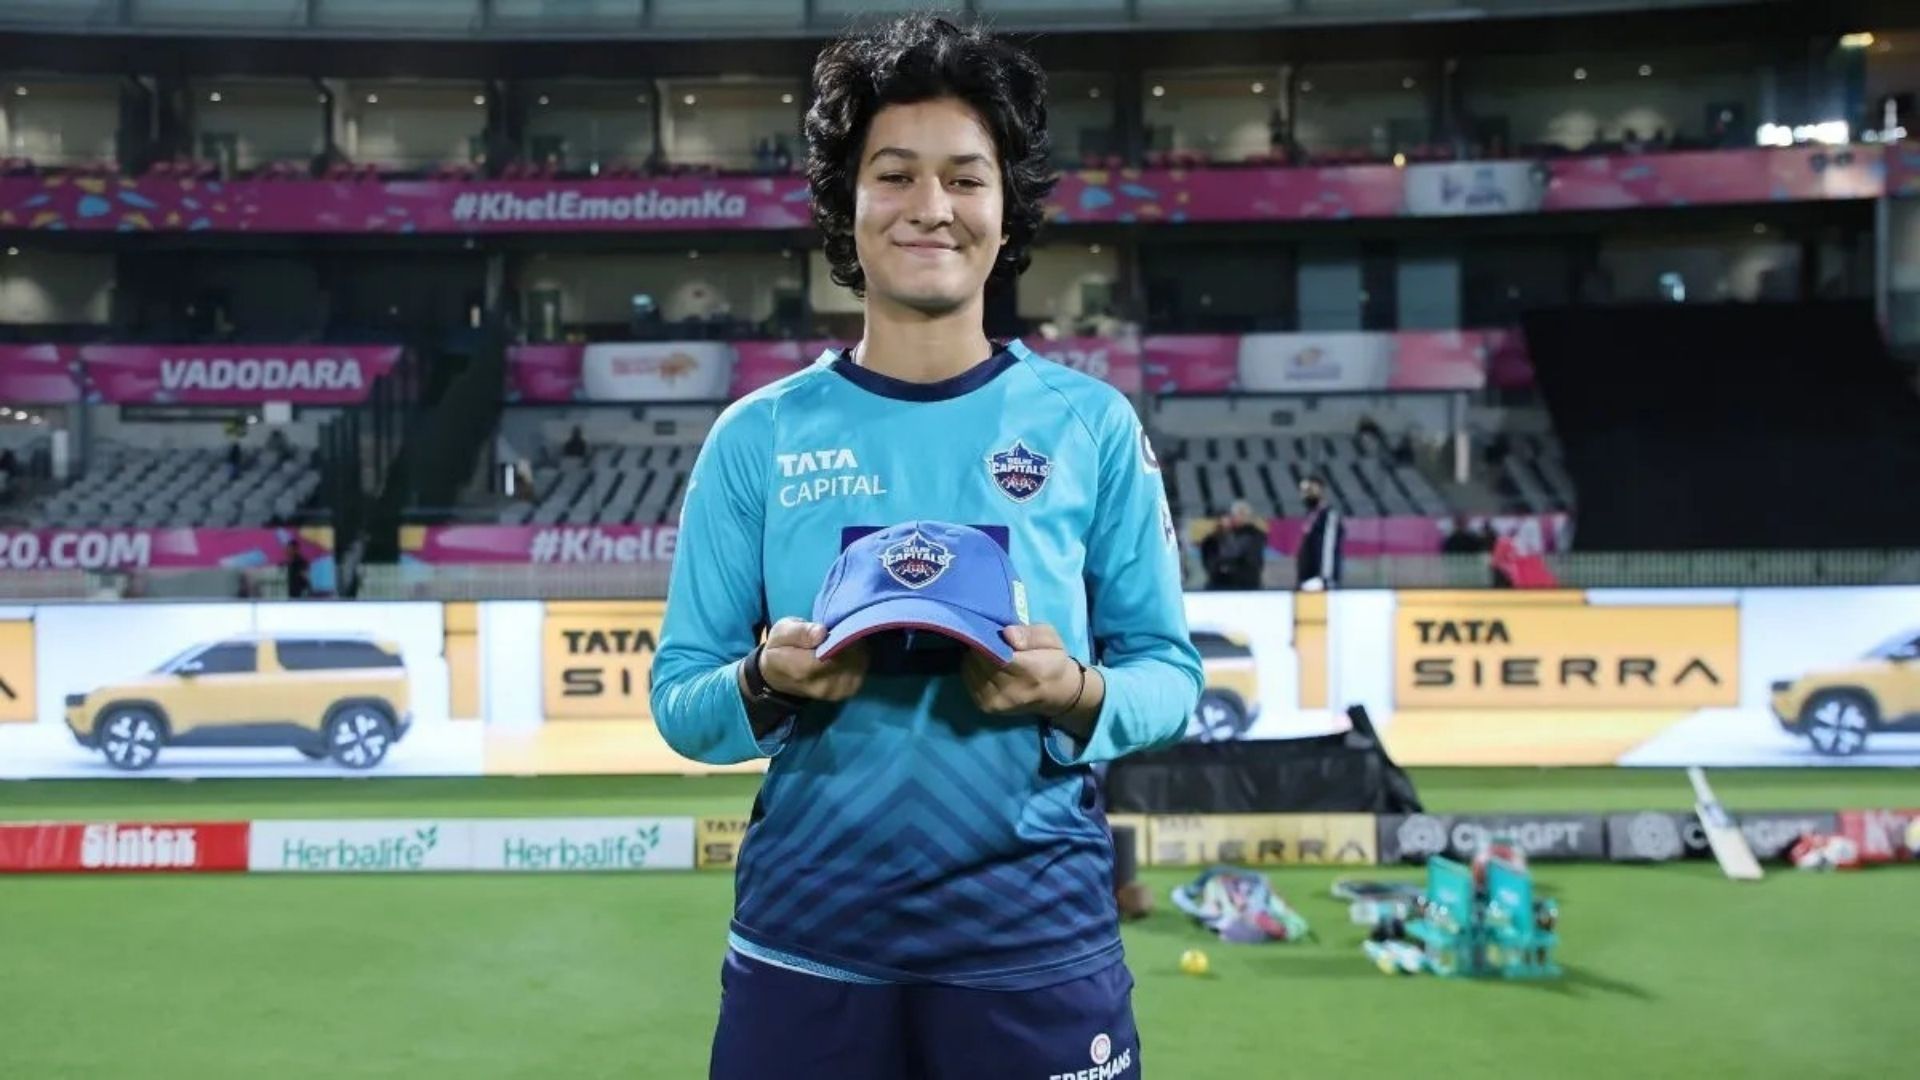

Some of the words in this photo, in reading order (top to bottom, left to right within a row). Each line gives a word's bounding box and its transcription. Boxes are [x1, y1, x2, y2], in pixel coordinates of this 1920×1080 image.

[453, 189, 746, 221] #KhelEmotionKa
[160, 358, 363, 390] VADODARA
[777, 448, 858, 477] TATA
[992, 461, 1048, 478] CAPITALS
[780, 474, 888, 508] CAPITAL
[886, 550, 946, 567] CAPITALS
[1414, 619, 1510, 644] TATA
[1413, 657, 1720, 687] SIERRA
[81, 823, 197, 868] Sintex
[282, 837, 425, 868] Herbalife
[503, 835, 648, 868] Herbalife
